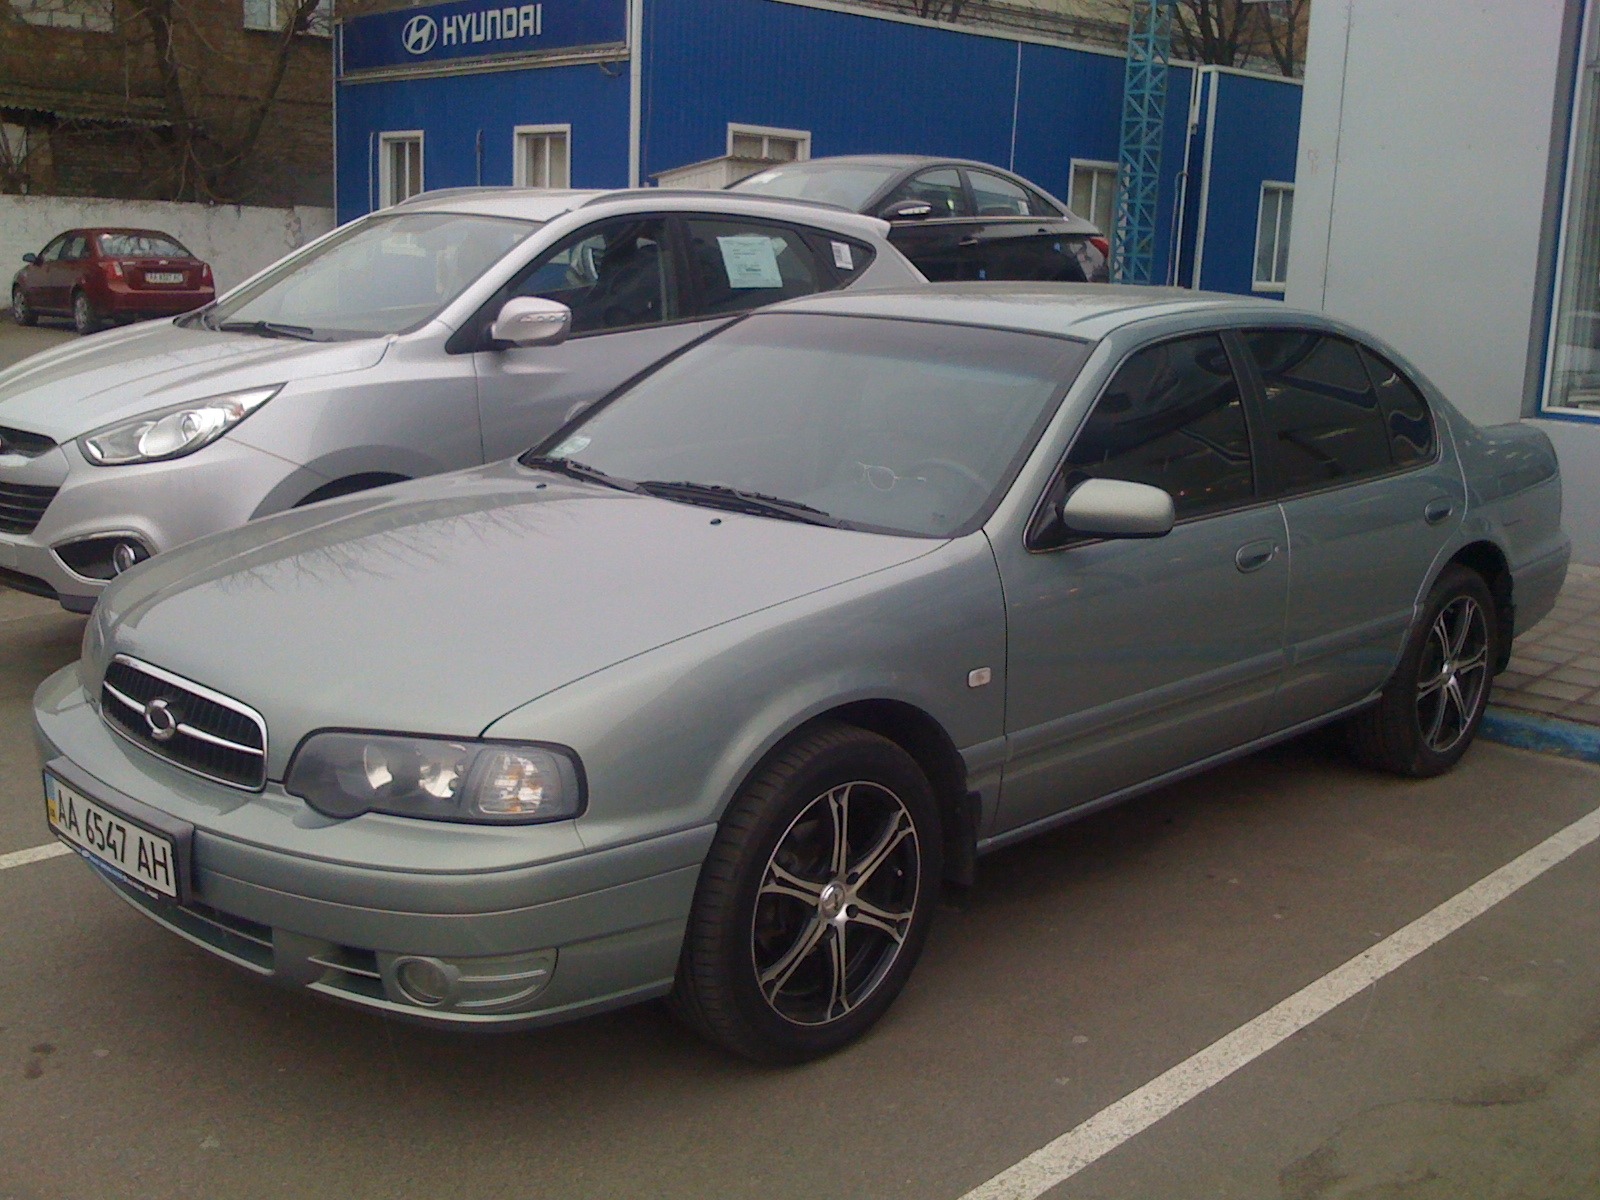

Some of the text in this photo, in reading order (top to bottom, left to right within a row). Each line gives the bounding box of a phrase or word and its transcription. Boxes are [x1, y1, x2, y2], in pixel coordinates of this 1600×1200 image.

[442, 3, 542, 47] HYUNDAI
[58, 789, 81, 837] AA
[85, 808, 127, 864] 6547
[137, 836, 170, 887] AH
